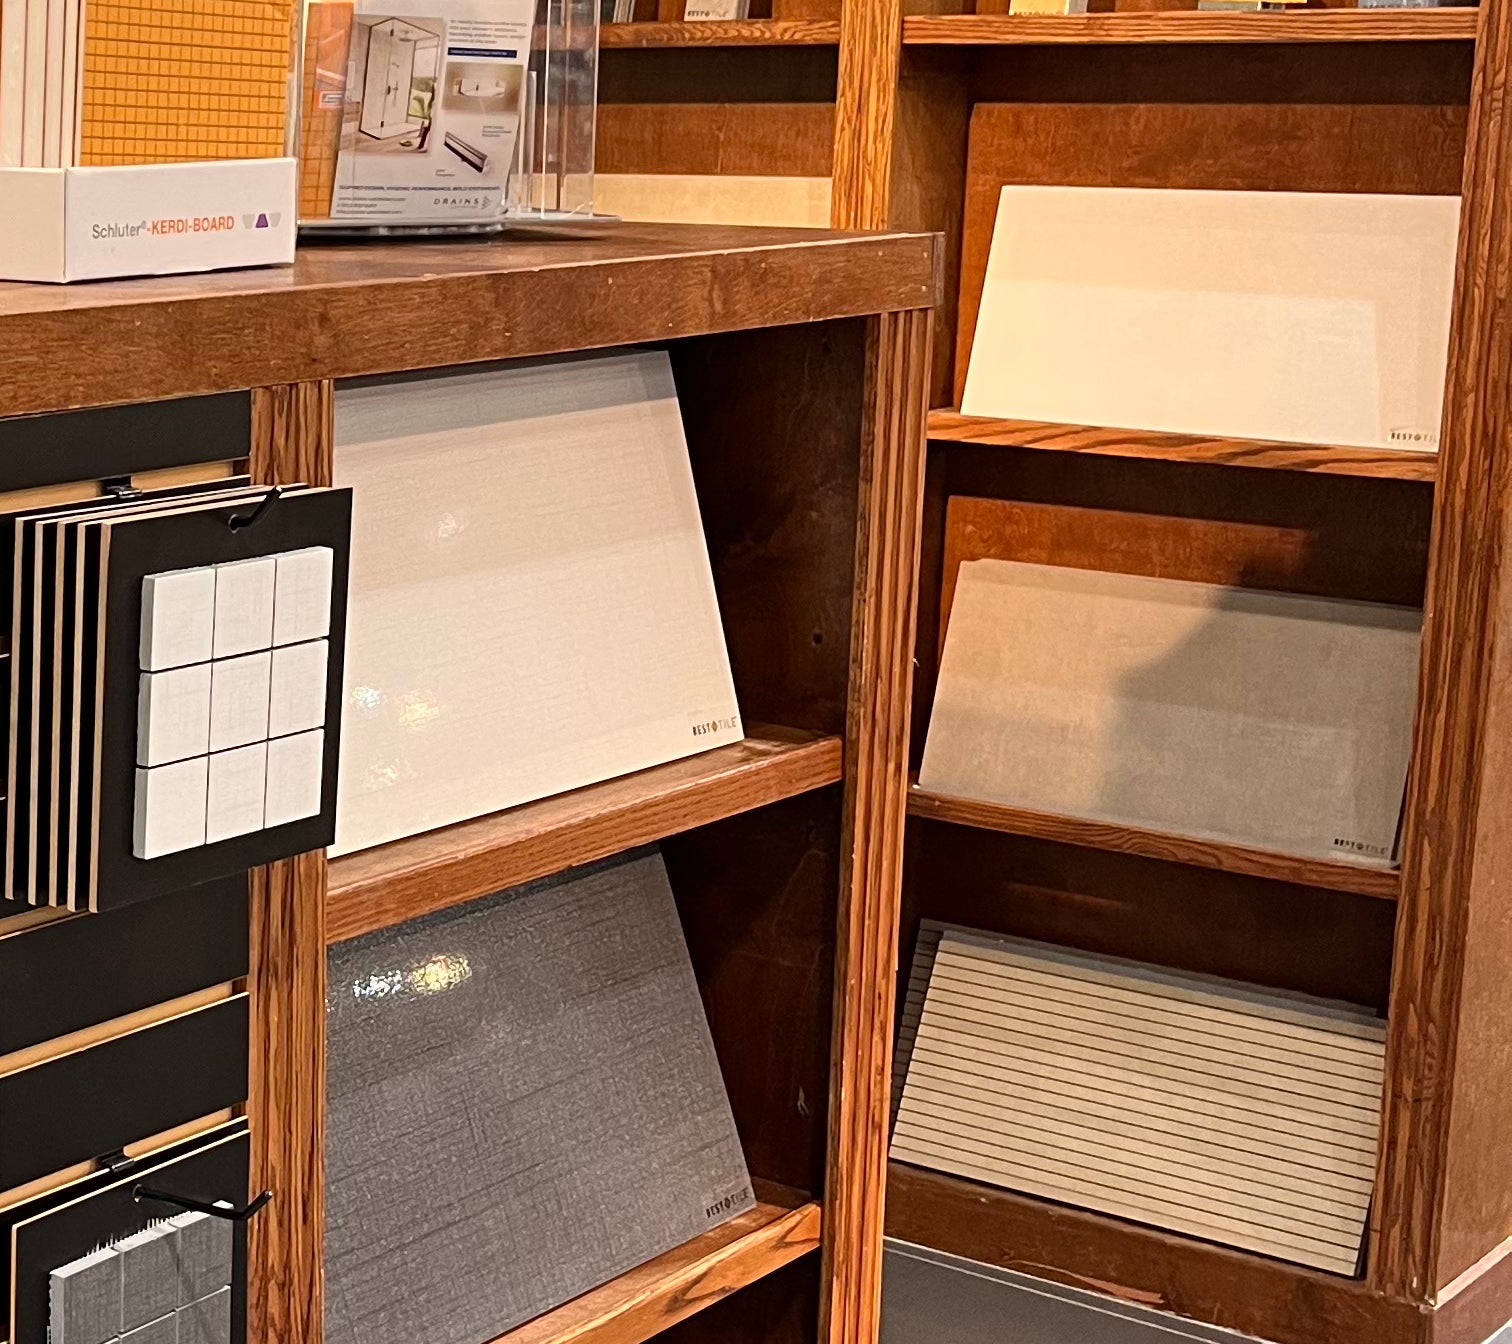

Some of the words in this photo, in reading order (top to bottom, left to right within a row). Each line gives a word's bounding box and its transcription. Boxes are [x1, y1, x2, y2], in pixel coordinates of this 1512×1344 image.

[433, 197, 480, 205] DRAINS
[692, 722, 710, 736] BEST
[718, 716, 737, 729] TILE
[705, 1199, 724, 1219] BEST
